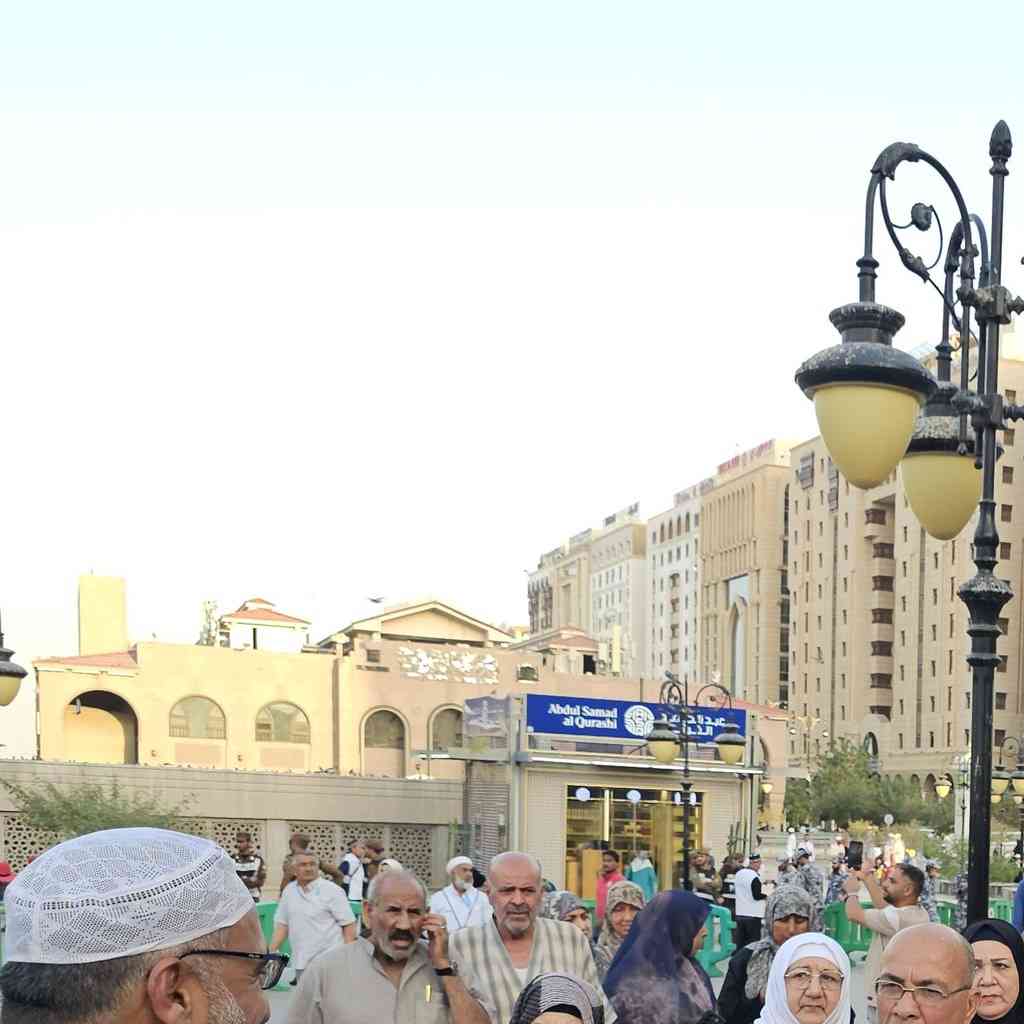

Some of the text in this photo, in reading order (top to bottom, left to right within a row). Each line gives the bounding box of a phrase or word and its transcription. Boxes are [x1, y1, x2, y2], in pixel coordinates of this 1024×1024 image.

[548, 703, 618, 718] Abdul Samad
[562, 716, 618, 729] al Qurashi
